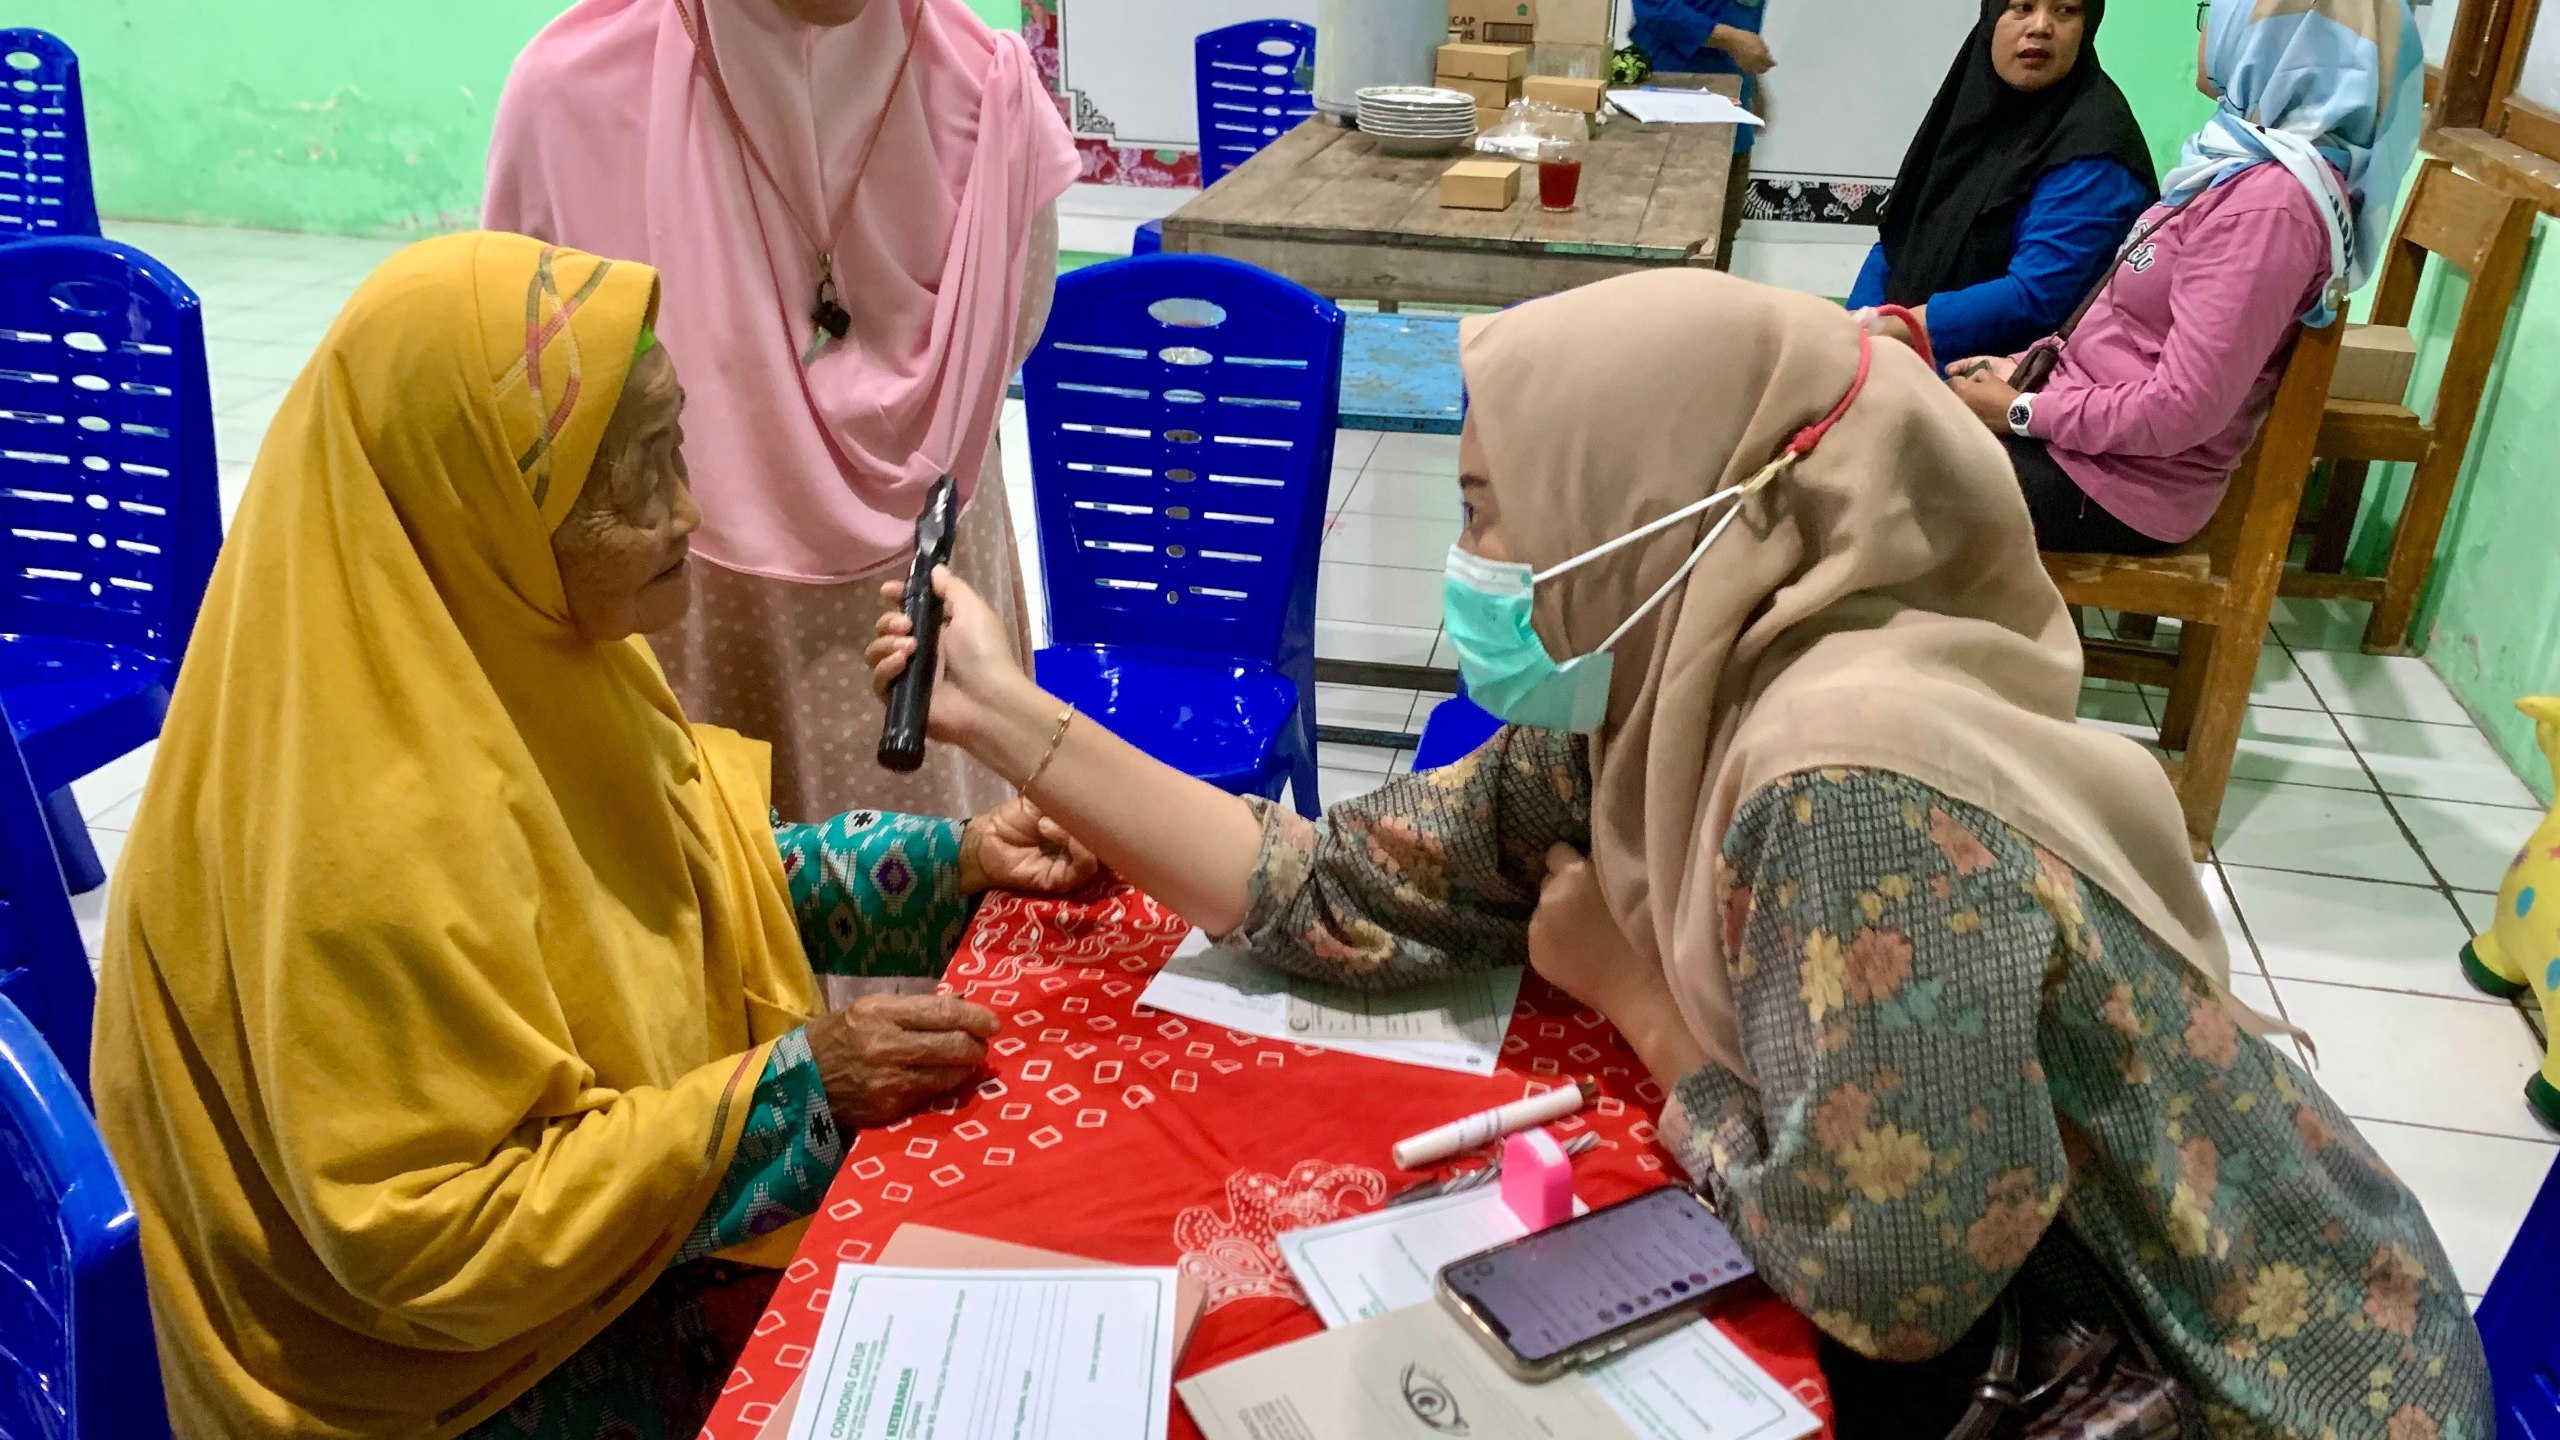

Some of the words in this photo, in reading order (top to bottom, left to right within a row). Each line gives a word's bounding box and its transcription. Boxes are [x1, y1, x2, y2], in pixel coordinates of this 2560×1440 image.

[830, 1380, 857, 1439] CONDONG
[847, 1341, 868, 1379] CATUR
[885, 1367, 913, 1437] KETERANGAN
